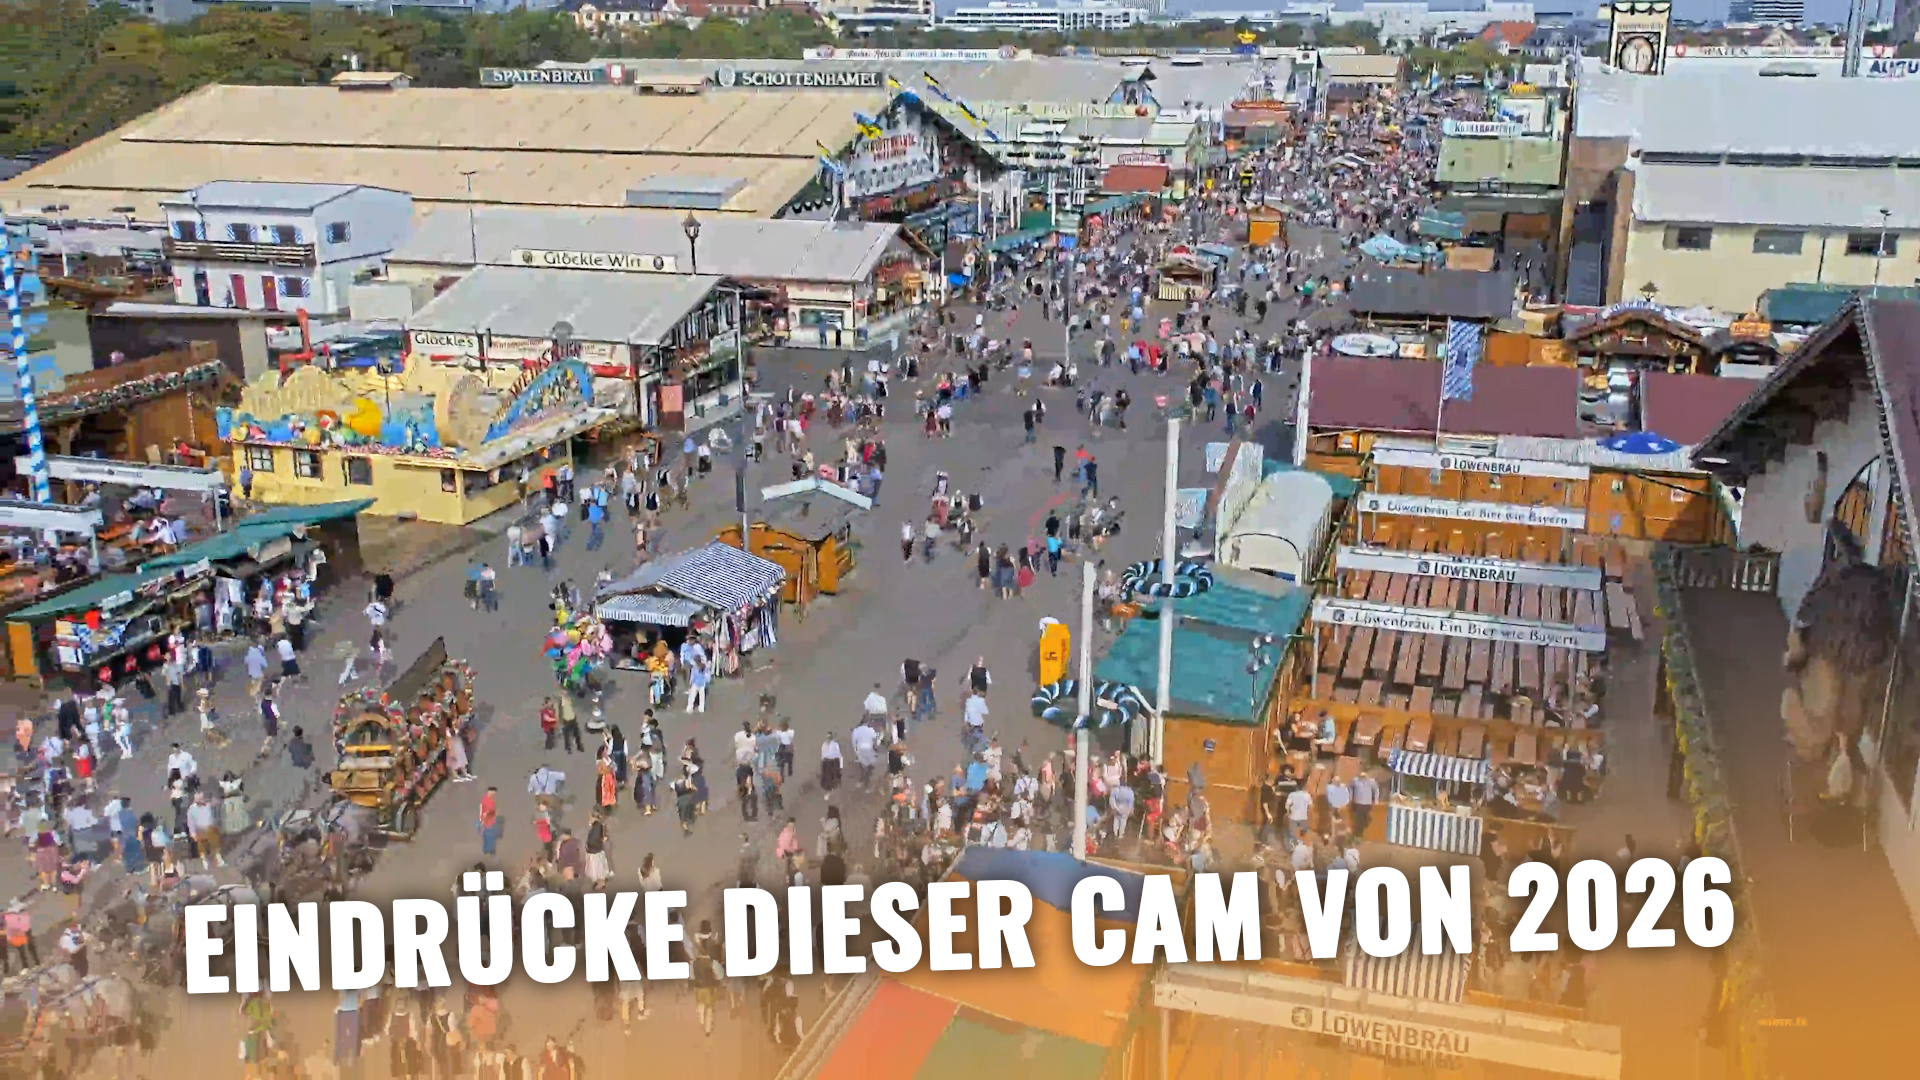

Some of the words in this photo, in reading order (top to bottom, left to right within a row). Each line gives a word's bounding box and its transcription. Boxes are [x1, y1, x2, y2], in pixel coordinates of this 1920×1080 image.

[742, 72, 878, 87] SCHOTTENHAMEL
[544, 251, 604, 266] Glöckle
[1440, 619, 1463, 634] Ein
[1468, 621, 1498, 637] Bier
[1322, 1009, 1470, 1054] LÖWENBRÄU
